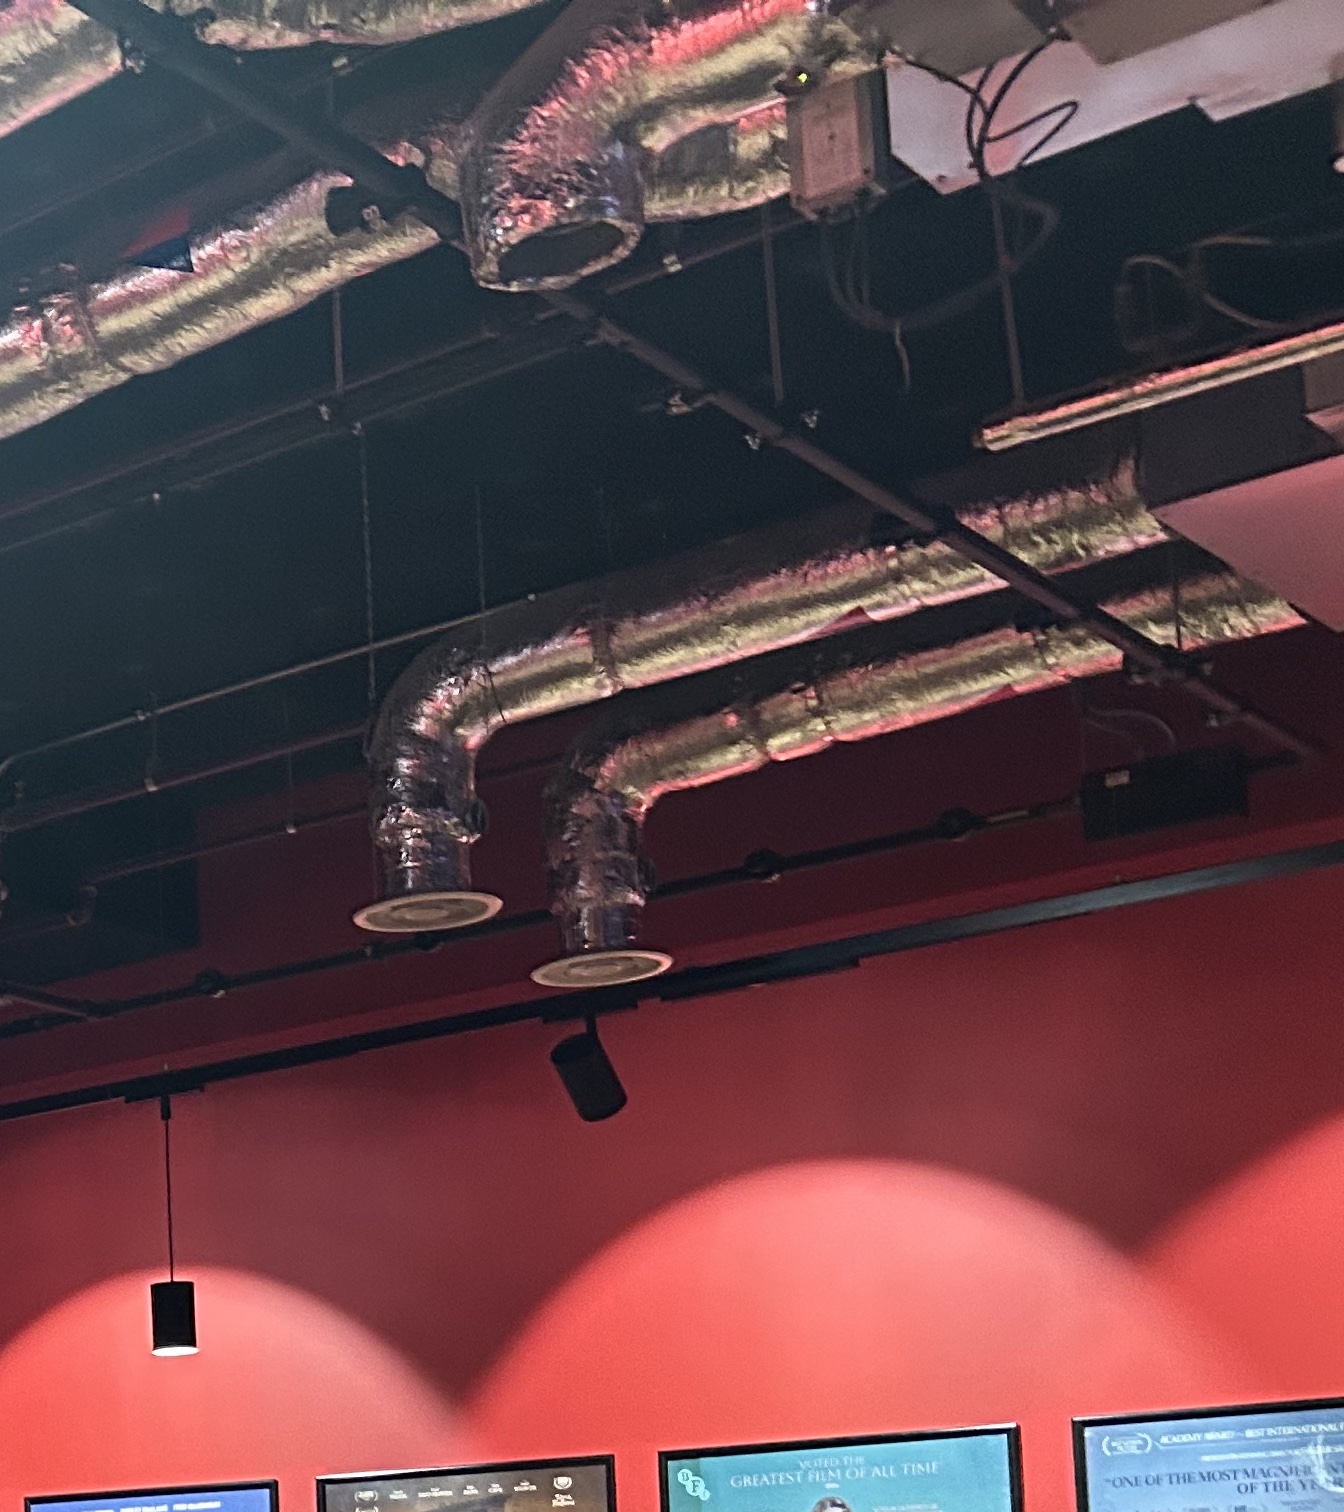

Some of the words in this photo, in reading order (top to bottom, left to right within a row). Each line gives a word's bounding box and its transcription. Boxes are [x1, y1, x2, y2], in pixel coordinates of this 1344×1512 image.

[730, 1471, 802, 1488] GREATEST
[807, 1468, 841, 1484] FILM
[845, 1466, 866, 1480] OF
[871, 1465, 897, 1479] ALL
[902, 1461, 940, 1475] TIME
[1166, 1472, 1196, 1486] THE
[1197, 1468, 1239, 1483] MOST
[1236, 1481, 1257, 1494] OF
[1262, 1480, 1292, 1493] THE
